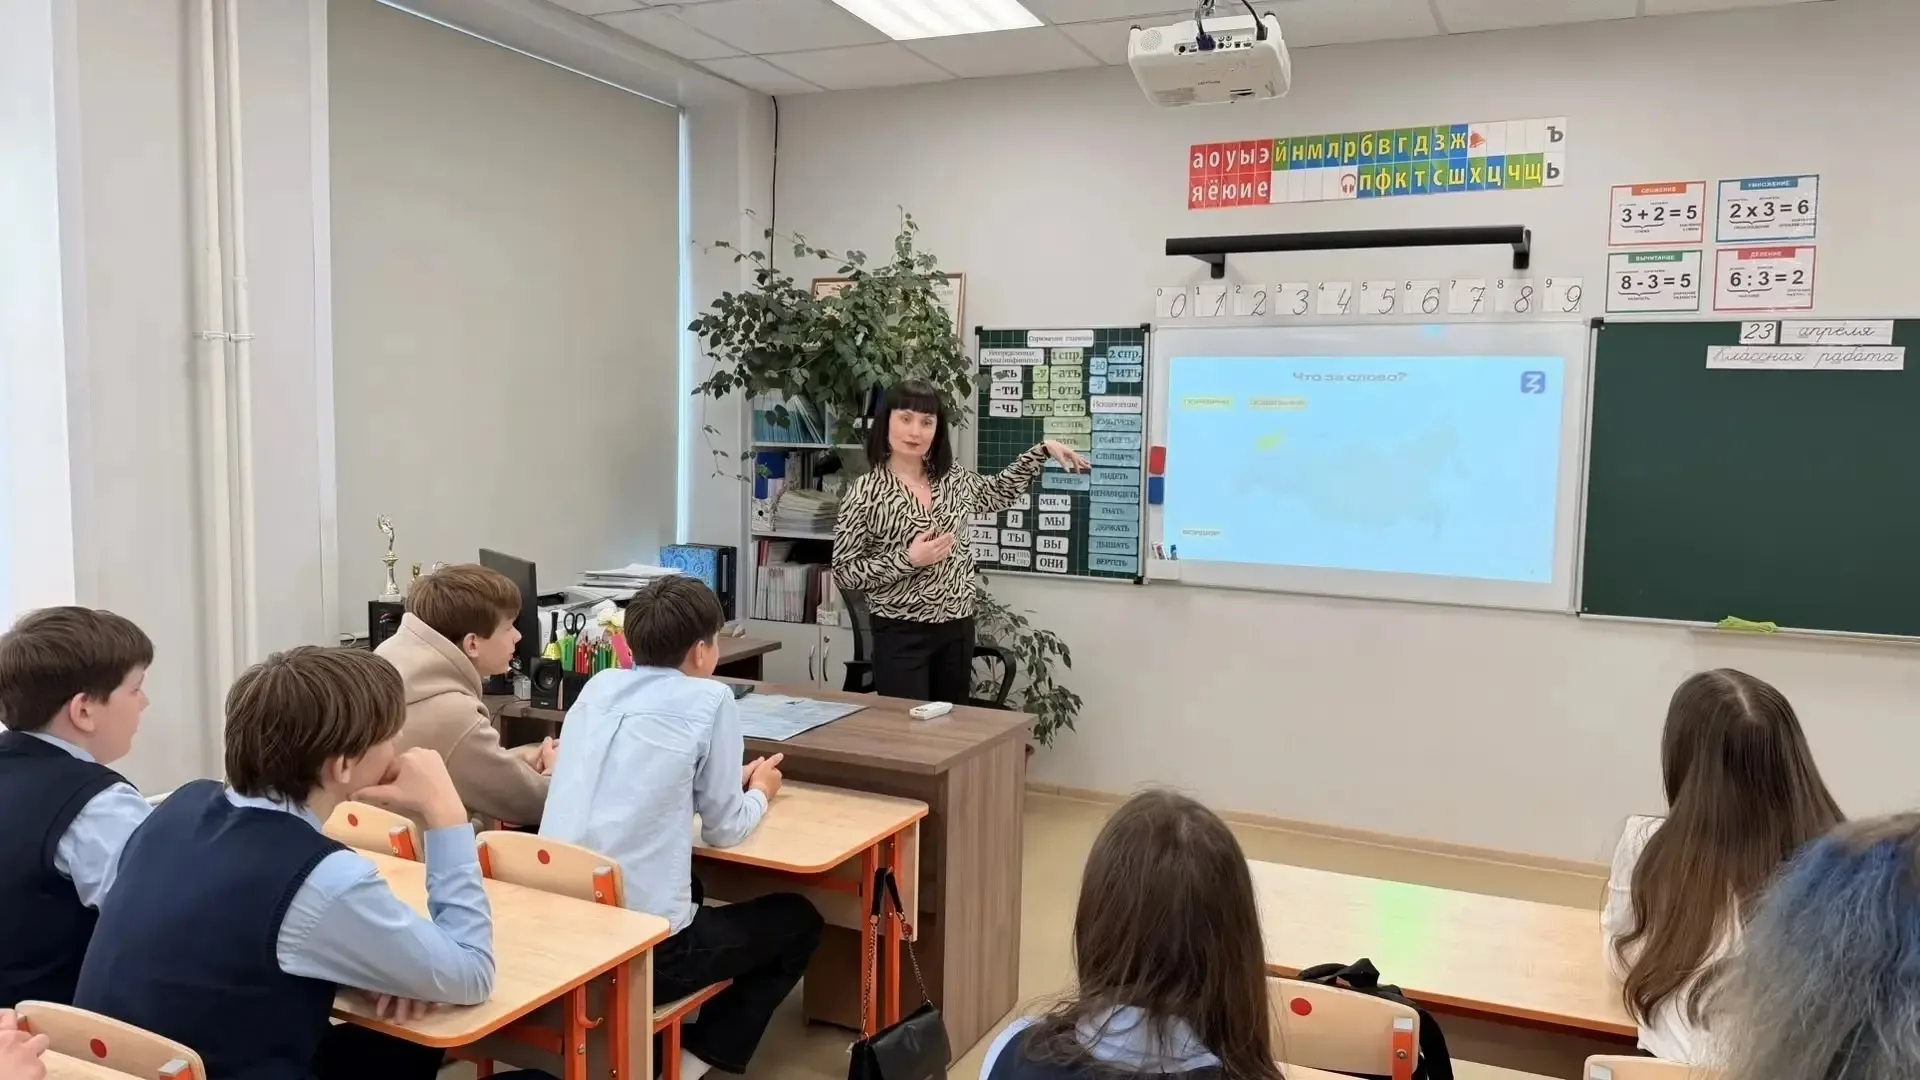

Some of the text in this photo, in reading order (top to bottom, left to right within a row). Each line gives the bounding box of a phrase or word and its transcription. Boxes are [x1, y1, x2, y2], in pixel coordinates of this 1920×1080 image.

[1622, 208, 1632, 223] 3
[1653, 206, 1664, 221] 2
[1686, 205, 1697, 220] 5
[1730, 203, 1741, 218] 2
[1763, 202, 1775, 216] 3
[1797, 199, 1809, 214] 6
[1196, 286, 1200, 295] 1
[1235, 285, 1241, 294] 2
[1276, 284, 1282, 293] 3
[1318, 283, 1325, 291] 4
[1362, 281, 1368, 291] 5
[1405, 281, 1412, 290] 6
[1451, 280, 1456, 289] 7
[1497, 279, 1504, 289] 8
[1545, 278, 1552, 288] 9
[1621, 275, 1631, 290] 8
[1648, 274, 1658, 289] 3
[1680, 273, 1691, 288] 5
[1730, 272, 1741, 287] 6
[1758, 271, 1769, 286] 3
[1792, 270, 1804, 285] 2
[1170, 285, 1582, 318] 0 1 2 3 4 5 6 7 8 9
[1743, 323, 1775, 339] 23
[1108, 350, 1116, 358] 2
[1292, 372, 1322, 382] Что
[1043, 540, 1062, 549] ВЫ
[1001, 552, 1016, 562] ОН
[1040, 558, 1064, 569] ОНИ
